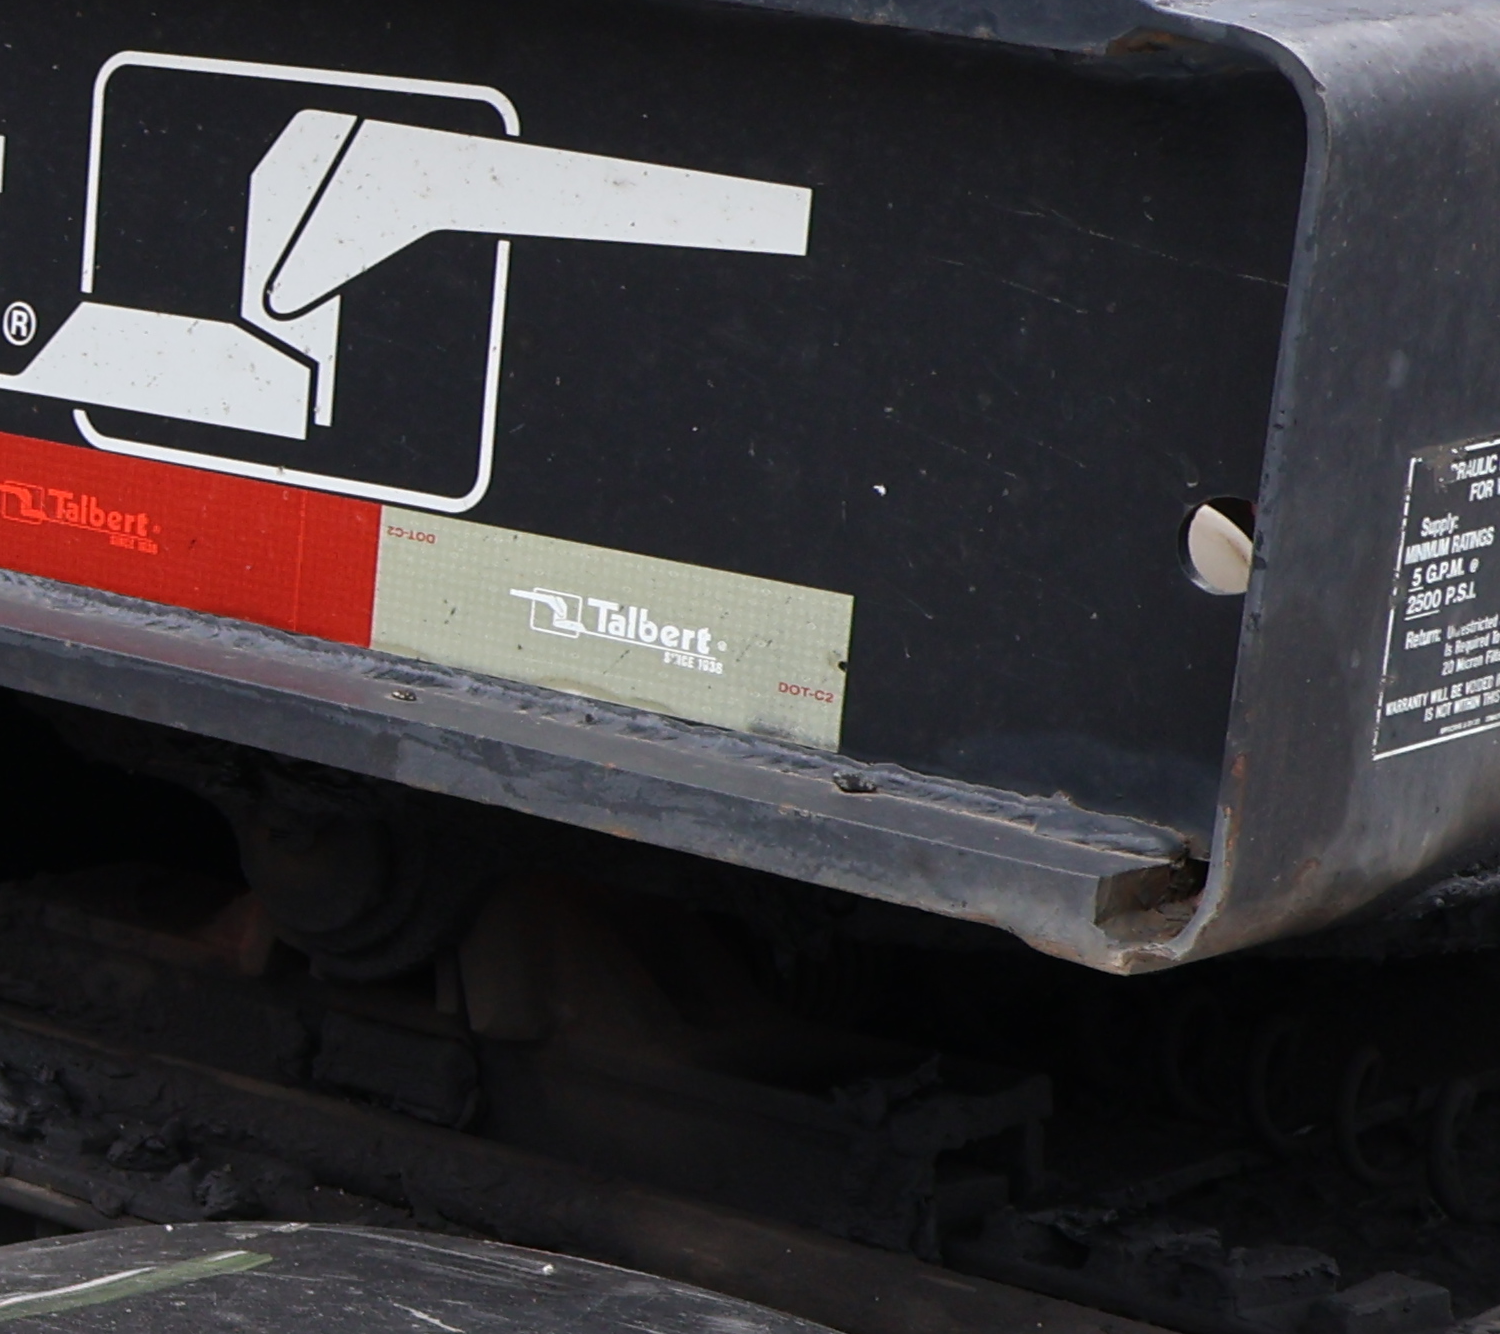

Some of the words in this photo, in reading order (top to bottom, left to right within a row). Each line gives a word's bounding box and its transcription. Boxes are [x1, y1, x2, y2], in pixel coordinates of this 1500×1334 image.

[1469, 479, 1494, 501] FOR
[46, 488, 150, 537] Talbert
[386, 525, 436, 545] DOT-C2
[1421, 512, 1459, 538] Supply:
[1451, 526, 1496, 554] RATINGS
[1411, 567, 1422, 587] 5
[1406, 589, 1442, 616] 2500
[588, 597, 713, 655] Talbert
[1405, 628, 1442, 651] Return:
[1455, 632, 1491, 655] Required
[1441, 660, 1455, 676] 20
[778, 681, 835, 703] DOT-C2
[1386, 691, 1429, 717] WARRANTY
